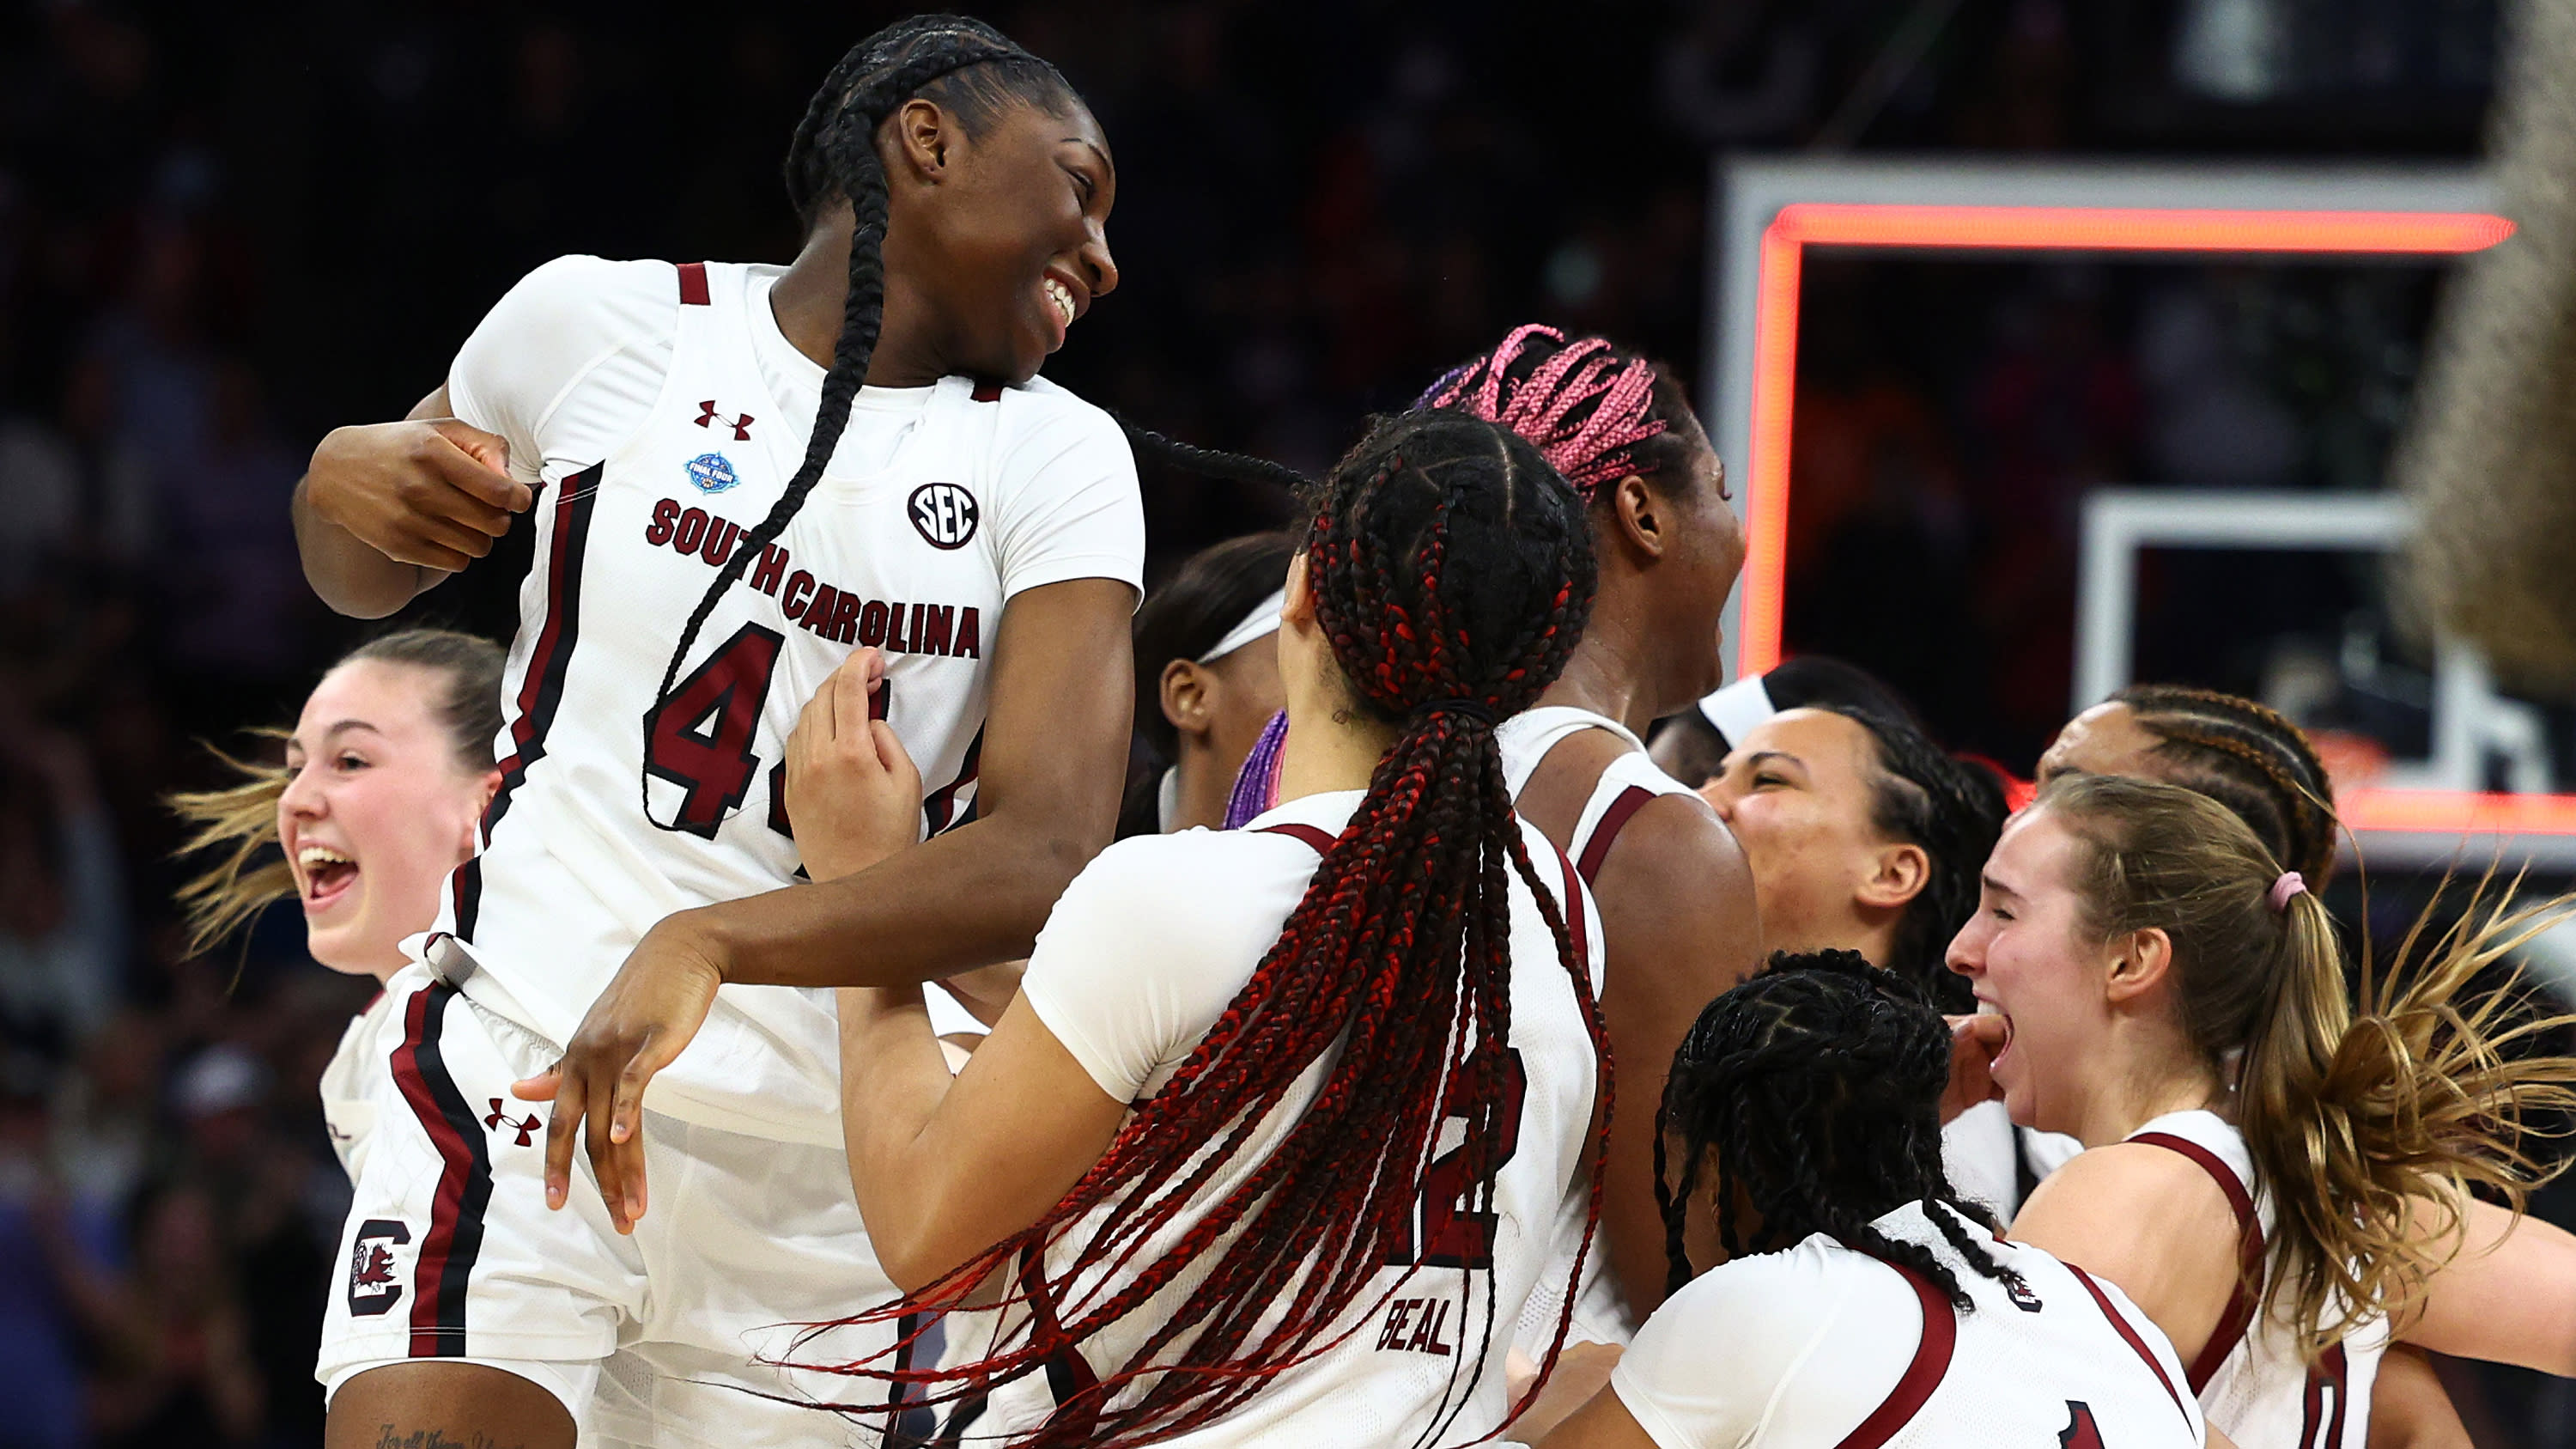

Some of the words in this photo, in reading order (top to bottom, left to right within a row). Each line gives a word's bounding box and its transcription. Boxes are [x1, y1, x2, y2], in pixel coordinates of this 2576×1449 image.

[689, 462, 712, 476] FINAL
[711, 469, 734, 483] FOUR
[914, 484, 975, 544] SEC
[645, 497, 790, 598] SOUH
[781, 569, 980, 660] CAROLINA
[1376, 1298, 1451, 1356] BEAL
